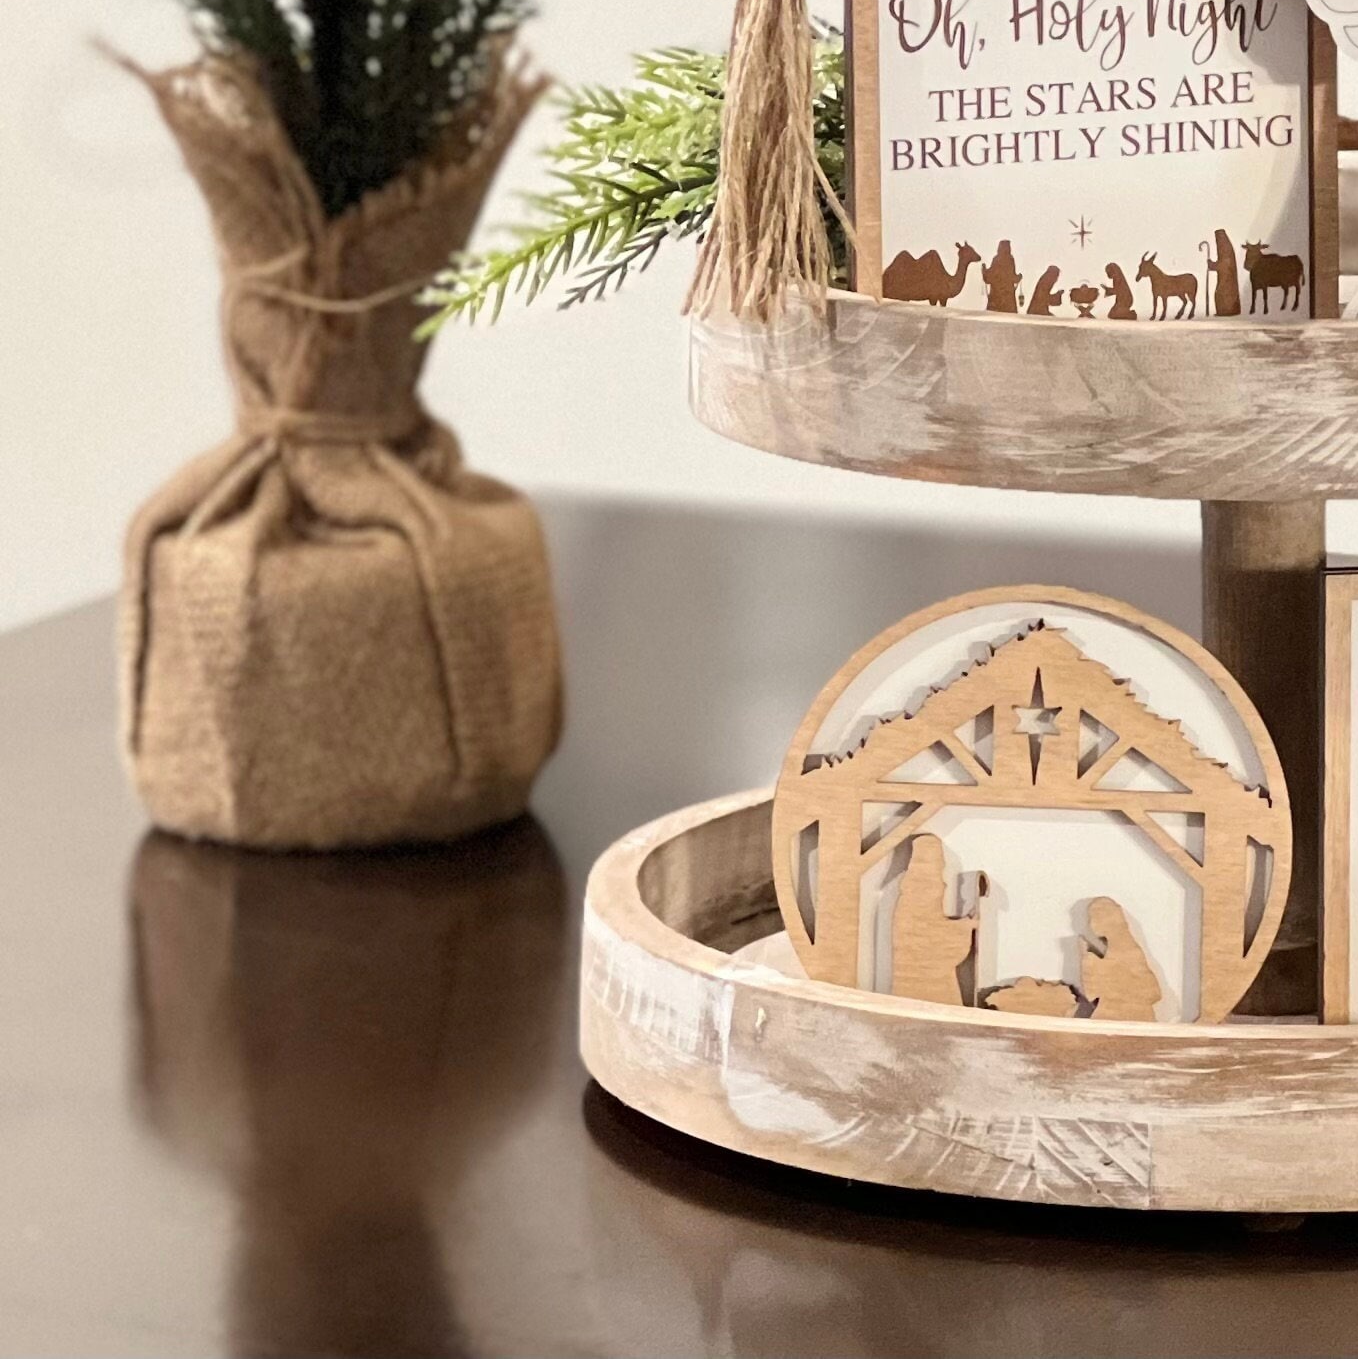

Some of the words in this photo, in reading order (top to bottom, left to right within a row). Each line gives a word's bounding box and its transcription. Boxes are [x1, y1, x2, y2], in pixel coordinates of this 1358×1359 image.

[928, 86, 1013, 123] THE
[1025, 77, 1157, 117] STARS
[1170, 71, 1255, 109] ARE
[890, 126, 1107, 171] BRIGHTLY
[1120, 114, 1294, 158] SHINING
